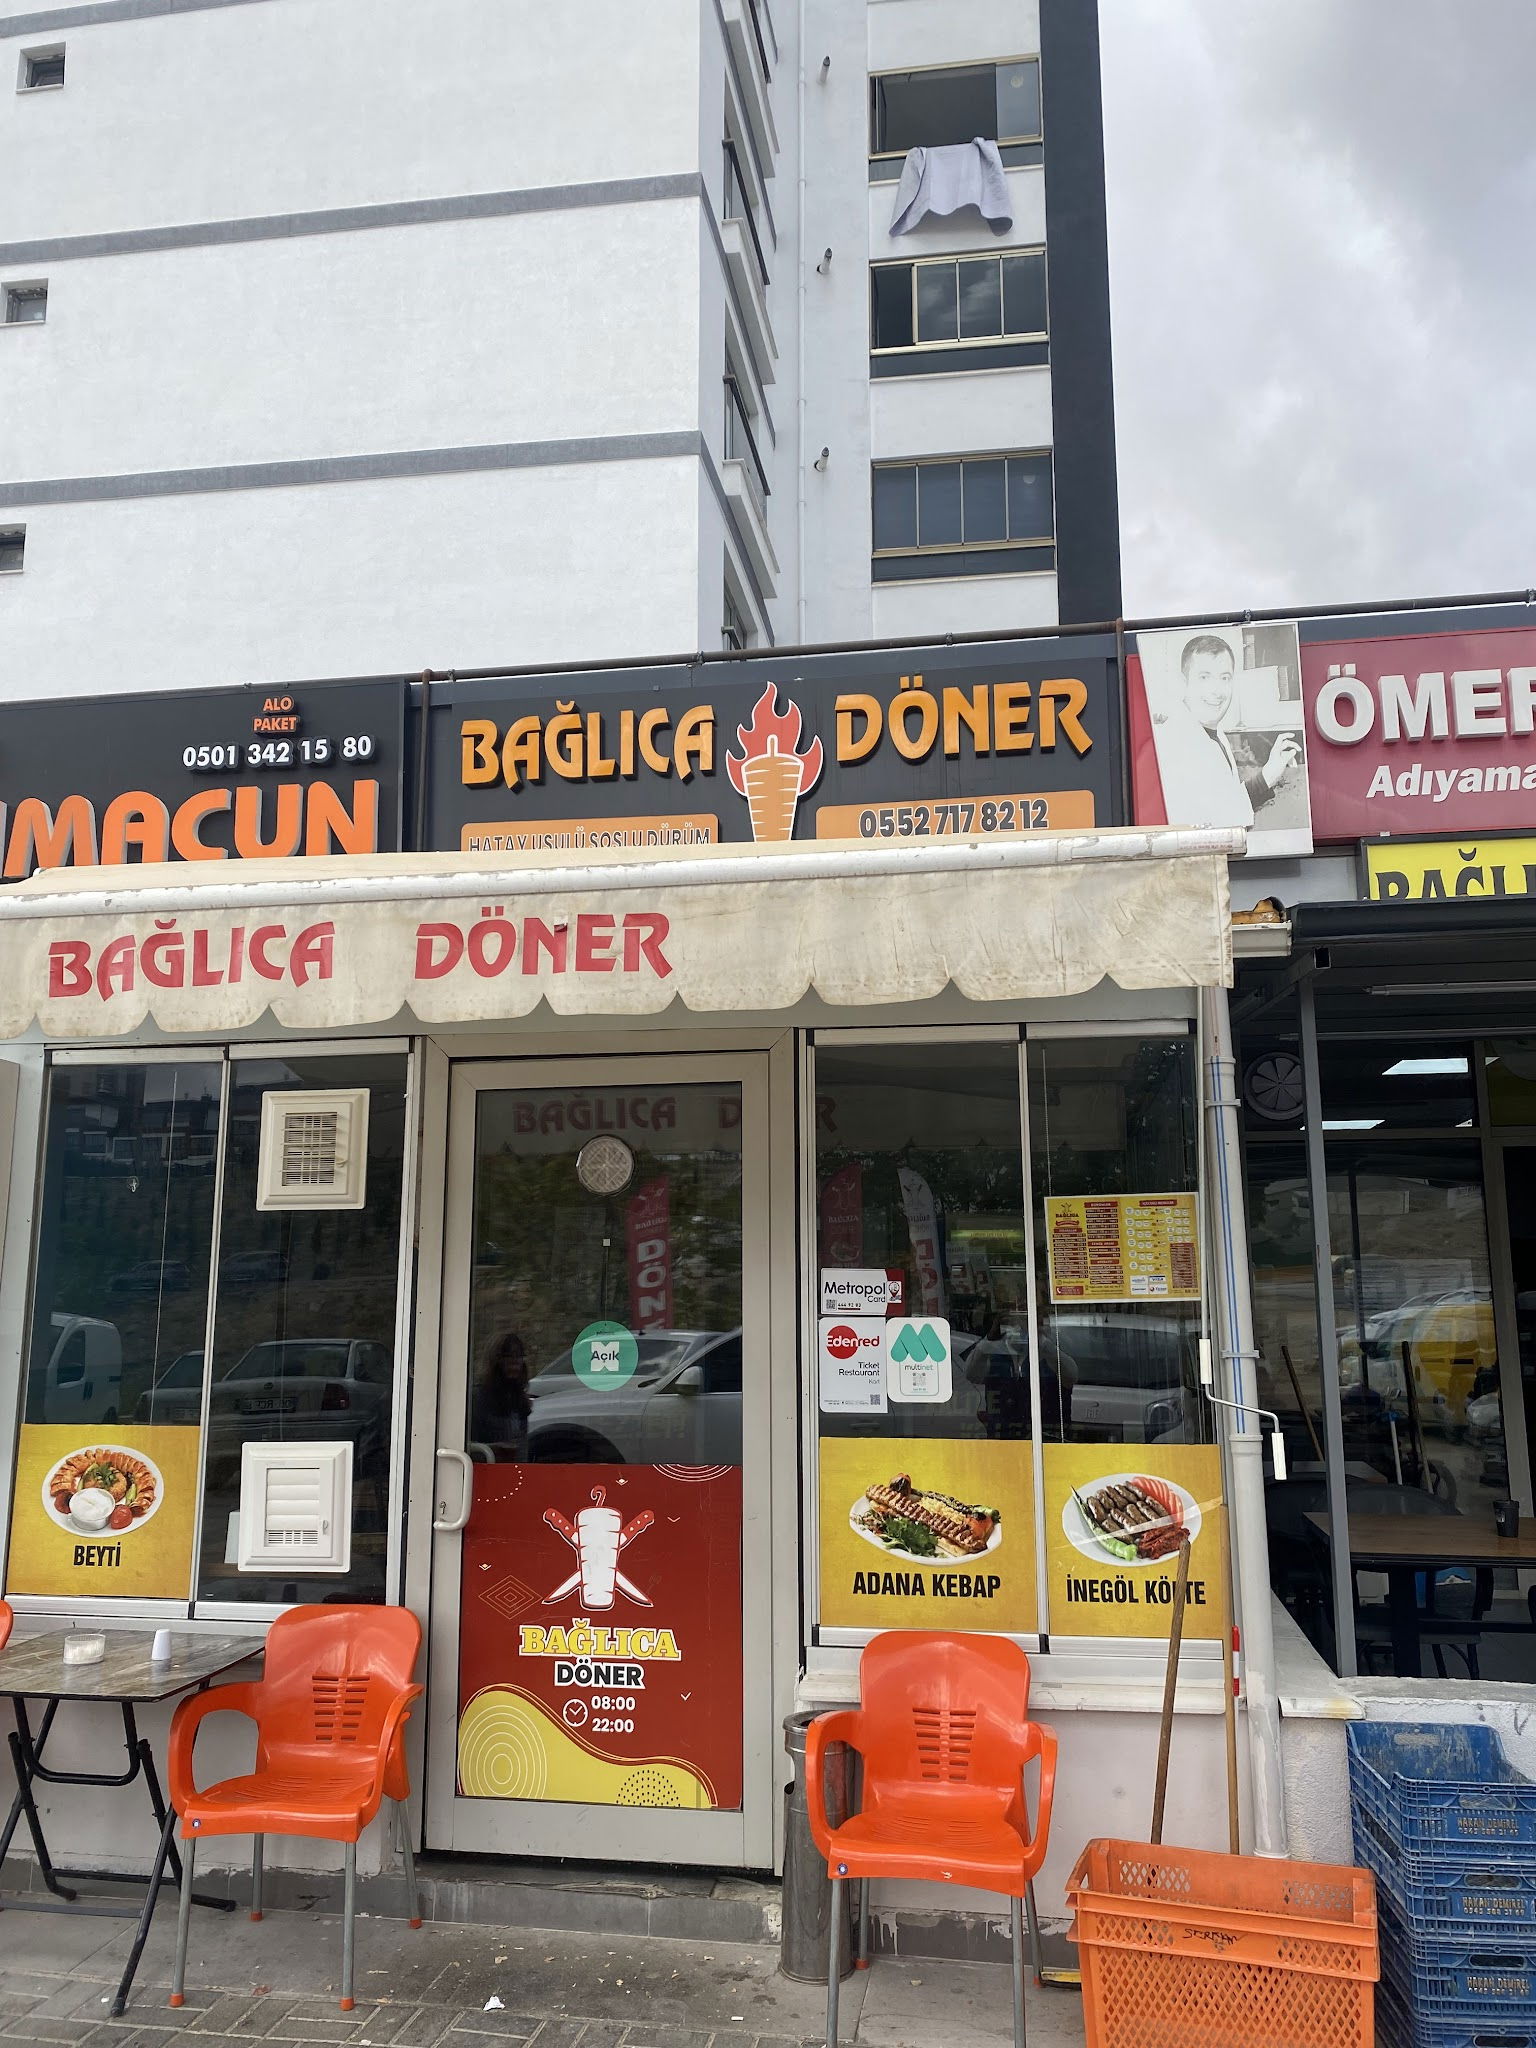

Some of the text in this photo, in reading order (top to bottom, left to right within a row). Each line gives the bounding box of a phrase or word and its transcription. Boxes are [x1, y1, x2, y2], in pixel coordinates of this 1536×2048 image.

[262, 696, 293, 711] ALO
[253, 716, 298, 731] PAKET
[460, 675, 1094, 791] BAĞLICA DÖNER
[182, 735, 372, 767] 0501 342 15 80
[859, 798, 1049, 838] 0552 717 82 12
[48, 906, 673, 1002] BAĞLICA DÖNER
[824, 1281, 886, 1297] Metropol
[867, 1295, 886, 1303] Card
[826, 1335, 880, 1347] Edenred
[591, 1350, 620, 1363] Açık
[838, 1368, 880, 1376] Restaurant
[858, 1361, 880, 1369] Ticket
[73, 1541, 121, 1567] BEYTİ
[853, 1571, 1001, 1599] ADANA KEBAP
[1066, 1574, 1139, 1604] İNEGÖL
[519, 1617, 682, 1661] BAĞLICA
[556, 1657, 643, 1687] DÖNER
[591, 1696, 636, 1711] 08:00
[591, 1718, 635, 1733] 22:00
